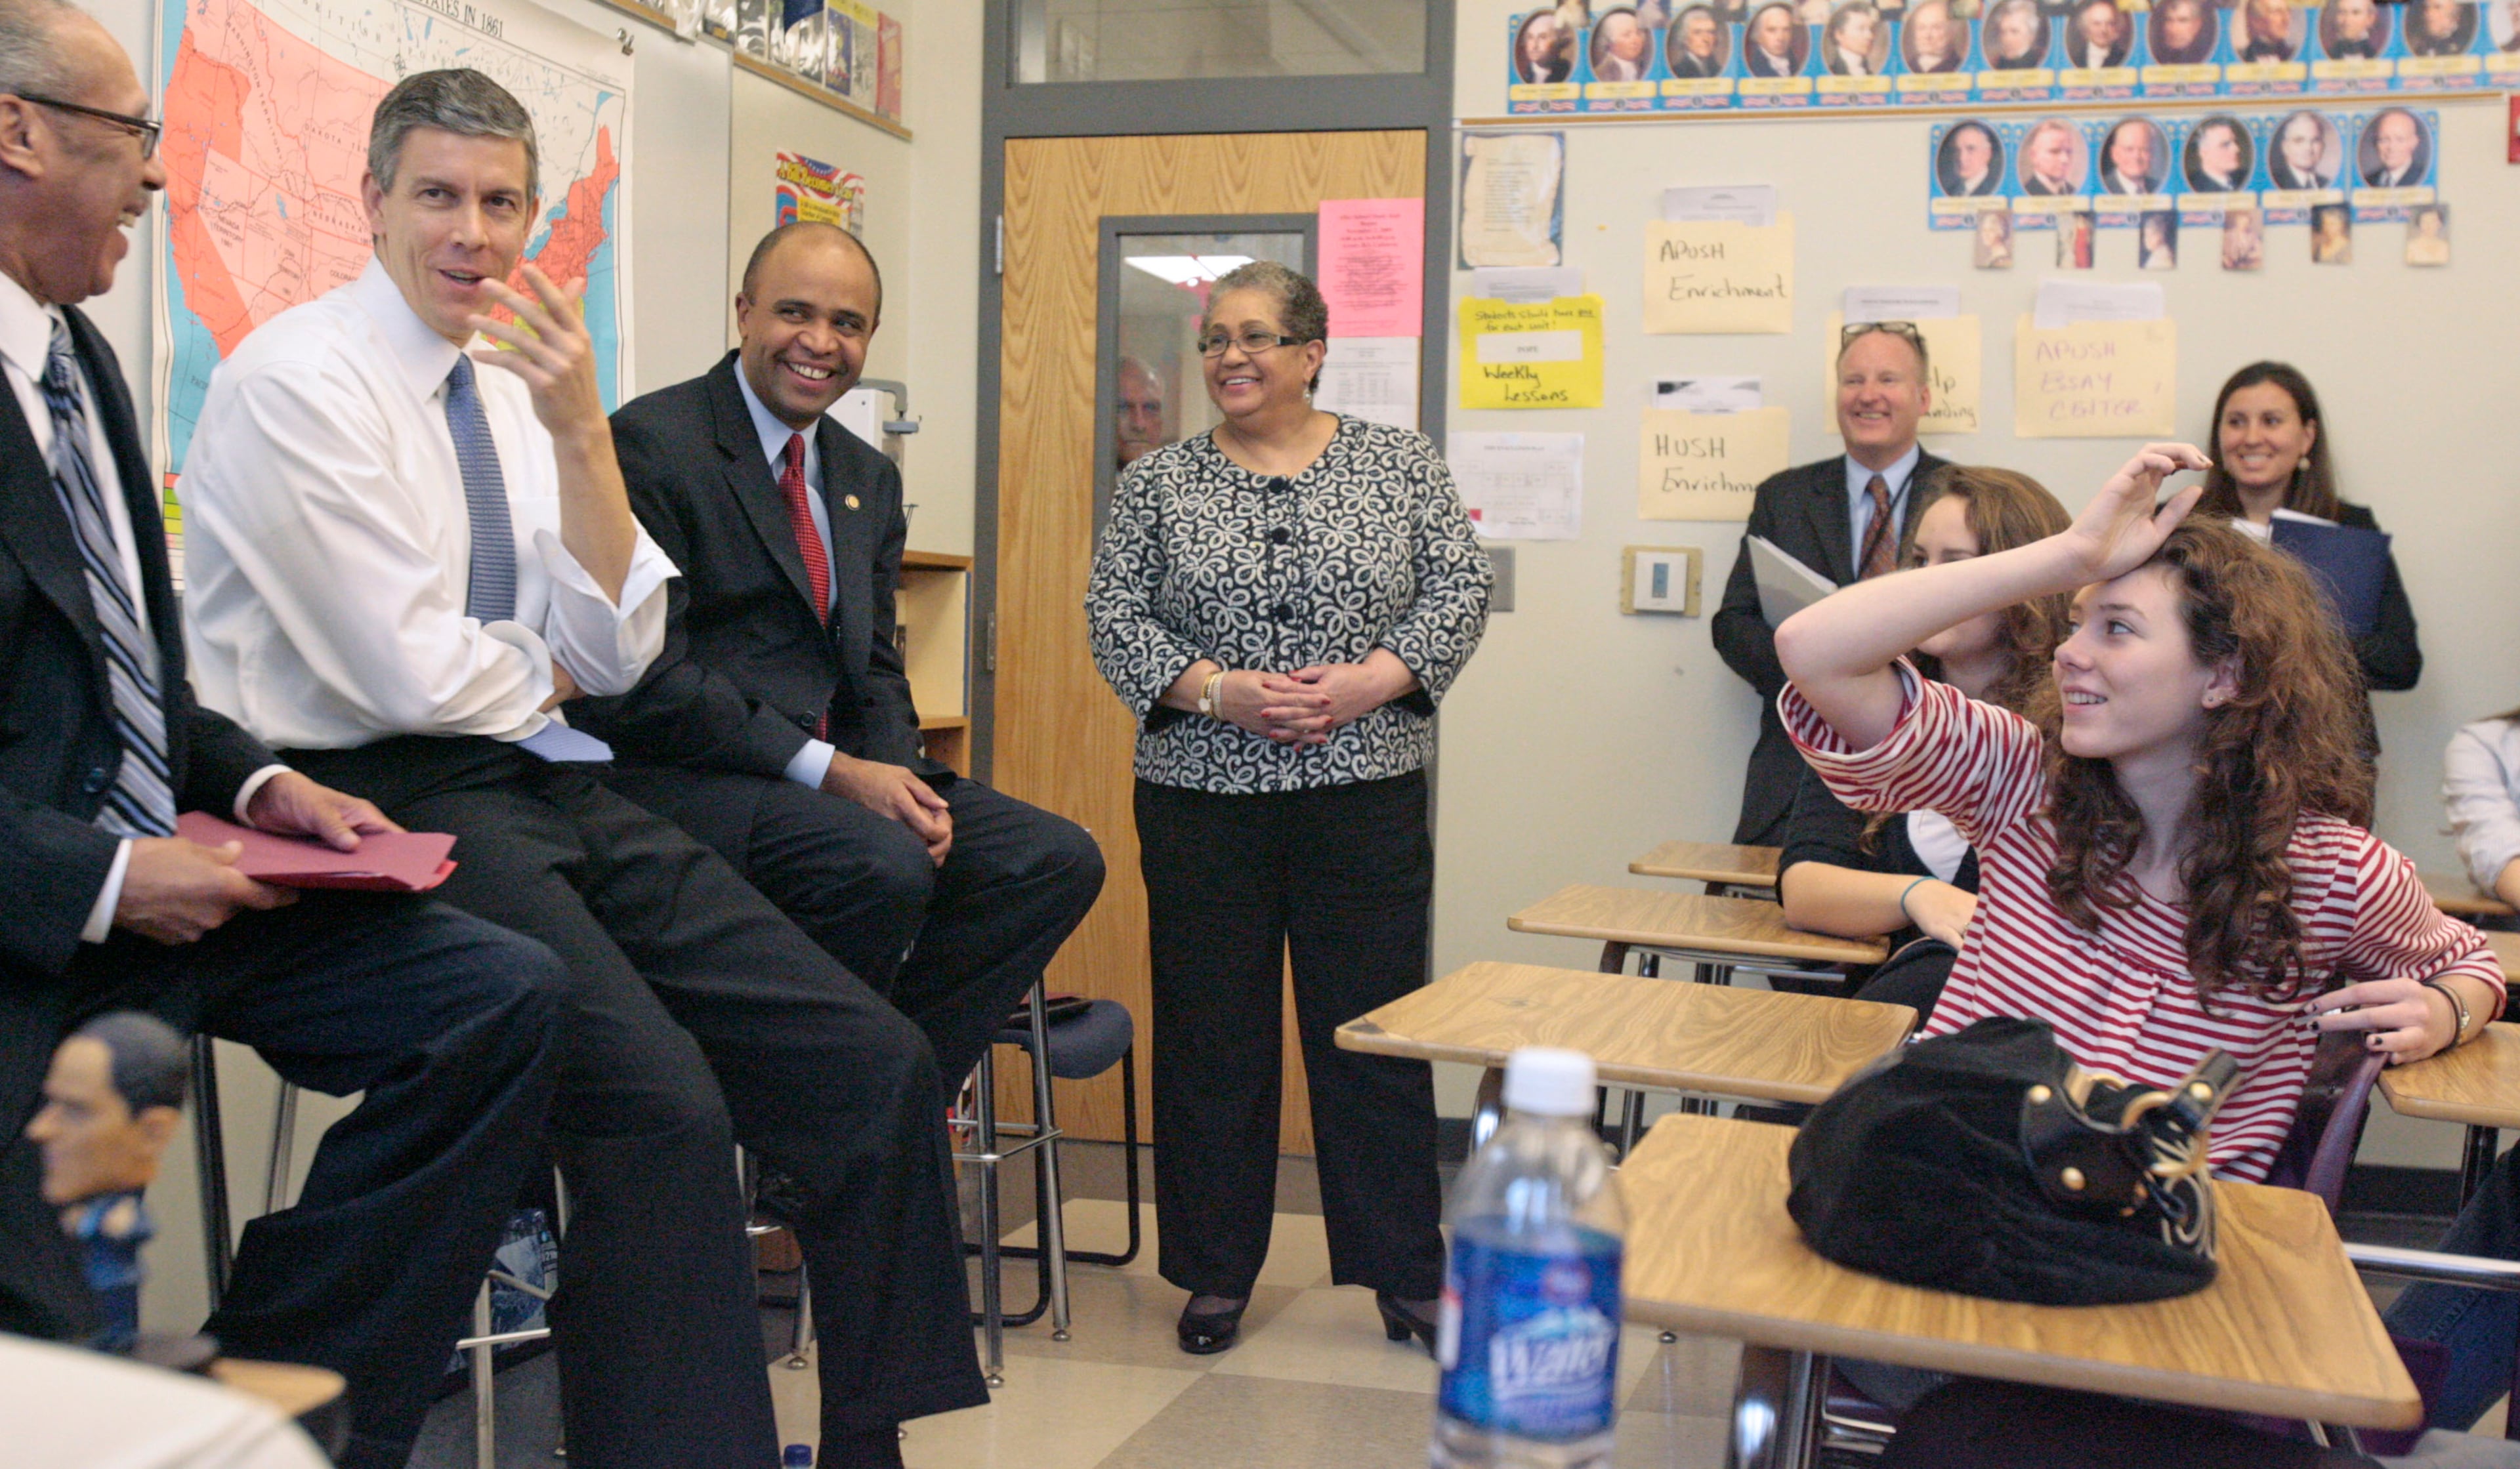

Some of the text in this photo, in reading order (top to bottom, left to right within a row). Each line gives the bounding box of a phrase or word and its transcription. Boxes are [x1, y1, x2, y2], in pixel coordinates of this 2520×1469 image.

[419, 0, 503, 38] ATES IN 1861
[1660, 239, 1725, 262] APUSH
[1669, 273, 1787, 301] Enrichment
[1929, 365, 1956, 394] lp
[2040, 370, 2112, 394] ESSAY
[1504, 383, 1568, 402] Lessons
[1655, 434, 1725, 458] HUSH
